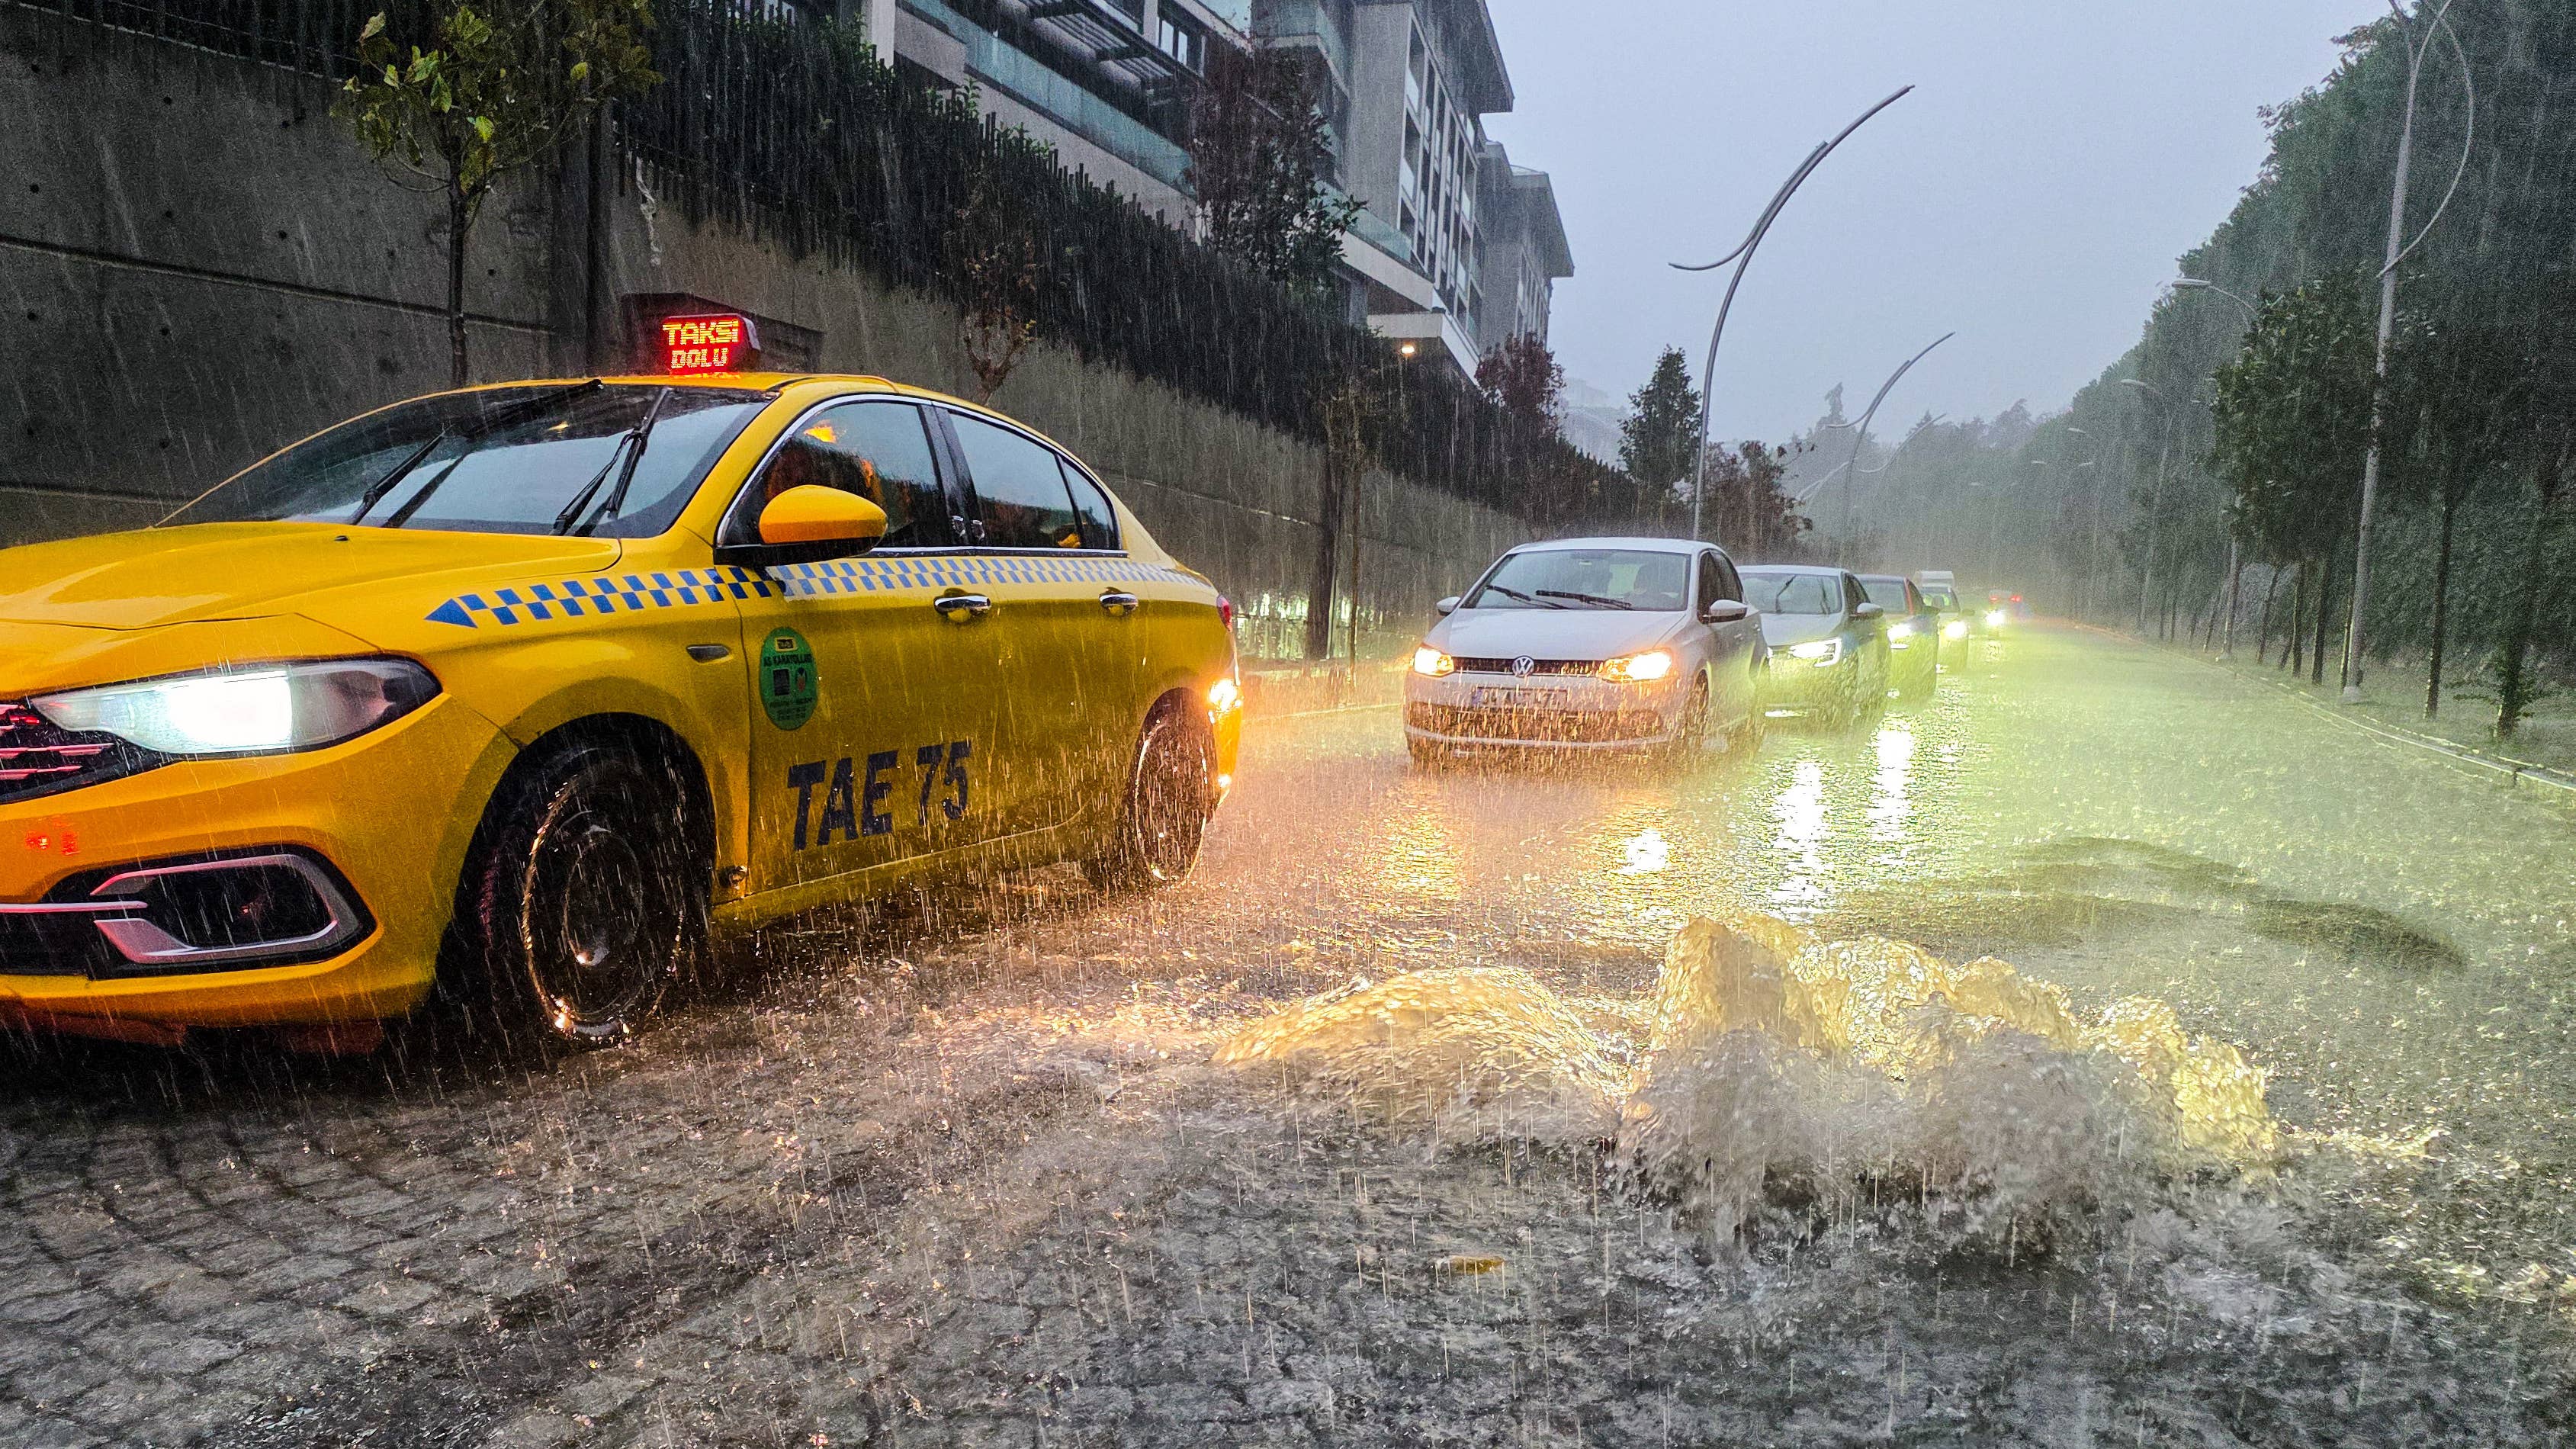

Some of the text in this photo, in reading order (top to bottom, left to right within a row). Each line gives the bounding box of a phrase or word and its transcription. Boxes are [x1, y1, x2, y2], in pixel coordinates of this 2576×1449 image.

[670, 347, 729, 369] DOLU
[787, 739, 972, 850] TAE 75
